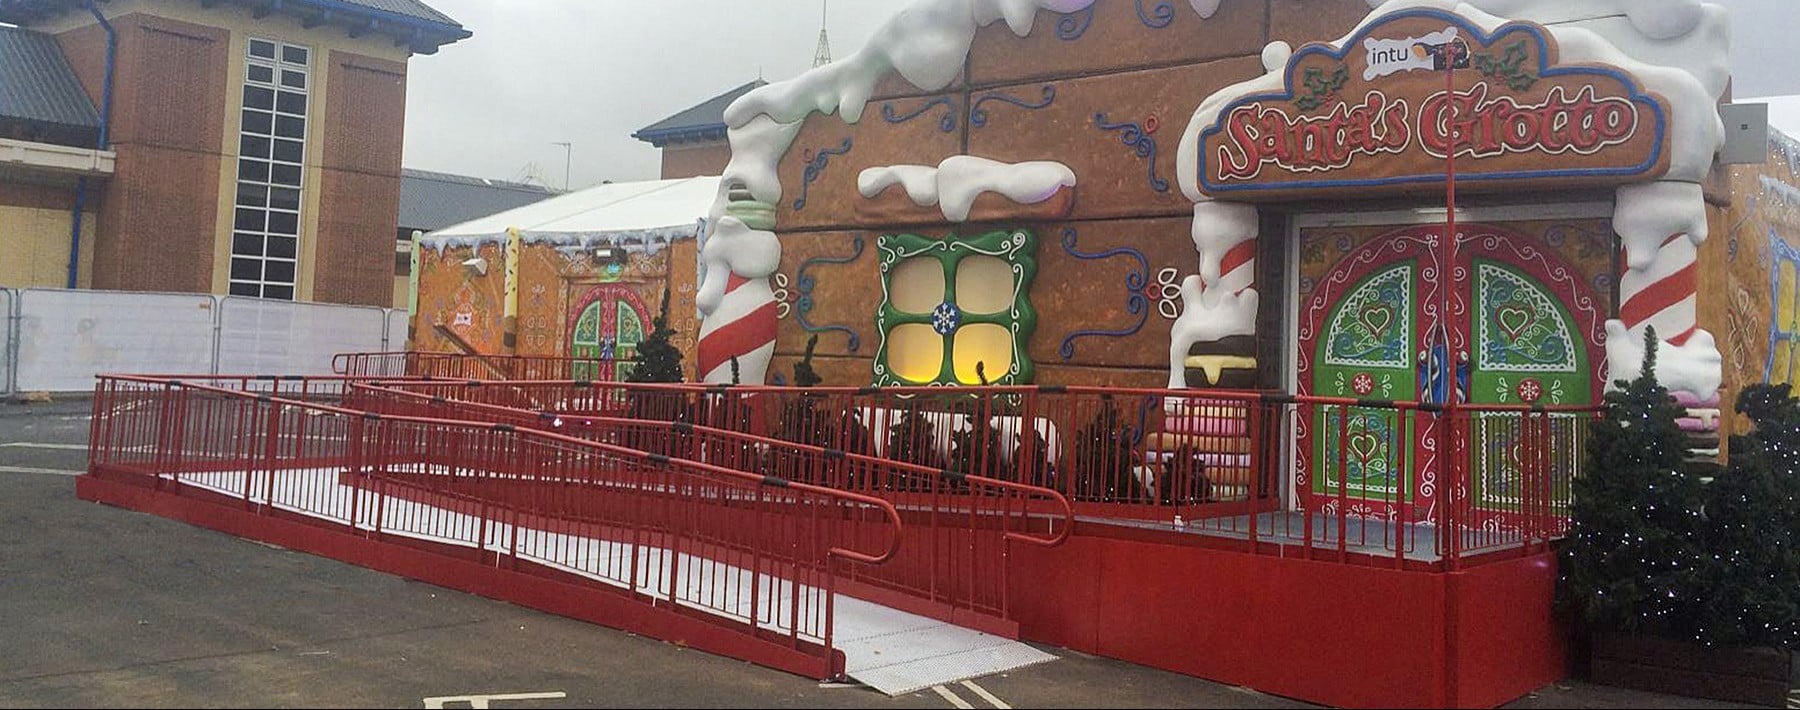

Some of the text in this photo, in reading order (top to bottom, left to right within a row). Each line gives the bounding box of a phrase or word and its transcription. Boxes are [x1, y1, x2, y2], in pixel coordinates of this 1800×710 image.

[1372, 47, 1408, 65] intu
[1219, 83, 1637, 178] Santa's Grotto
